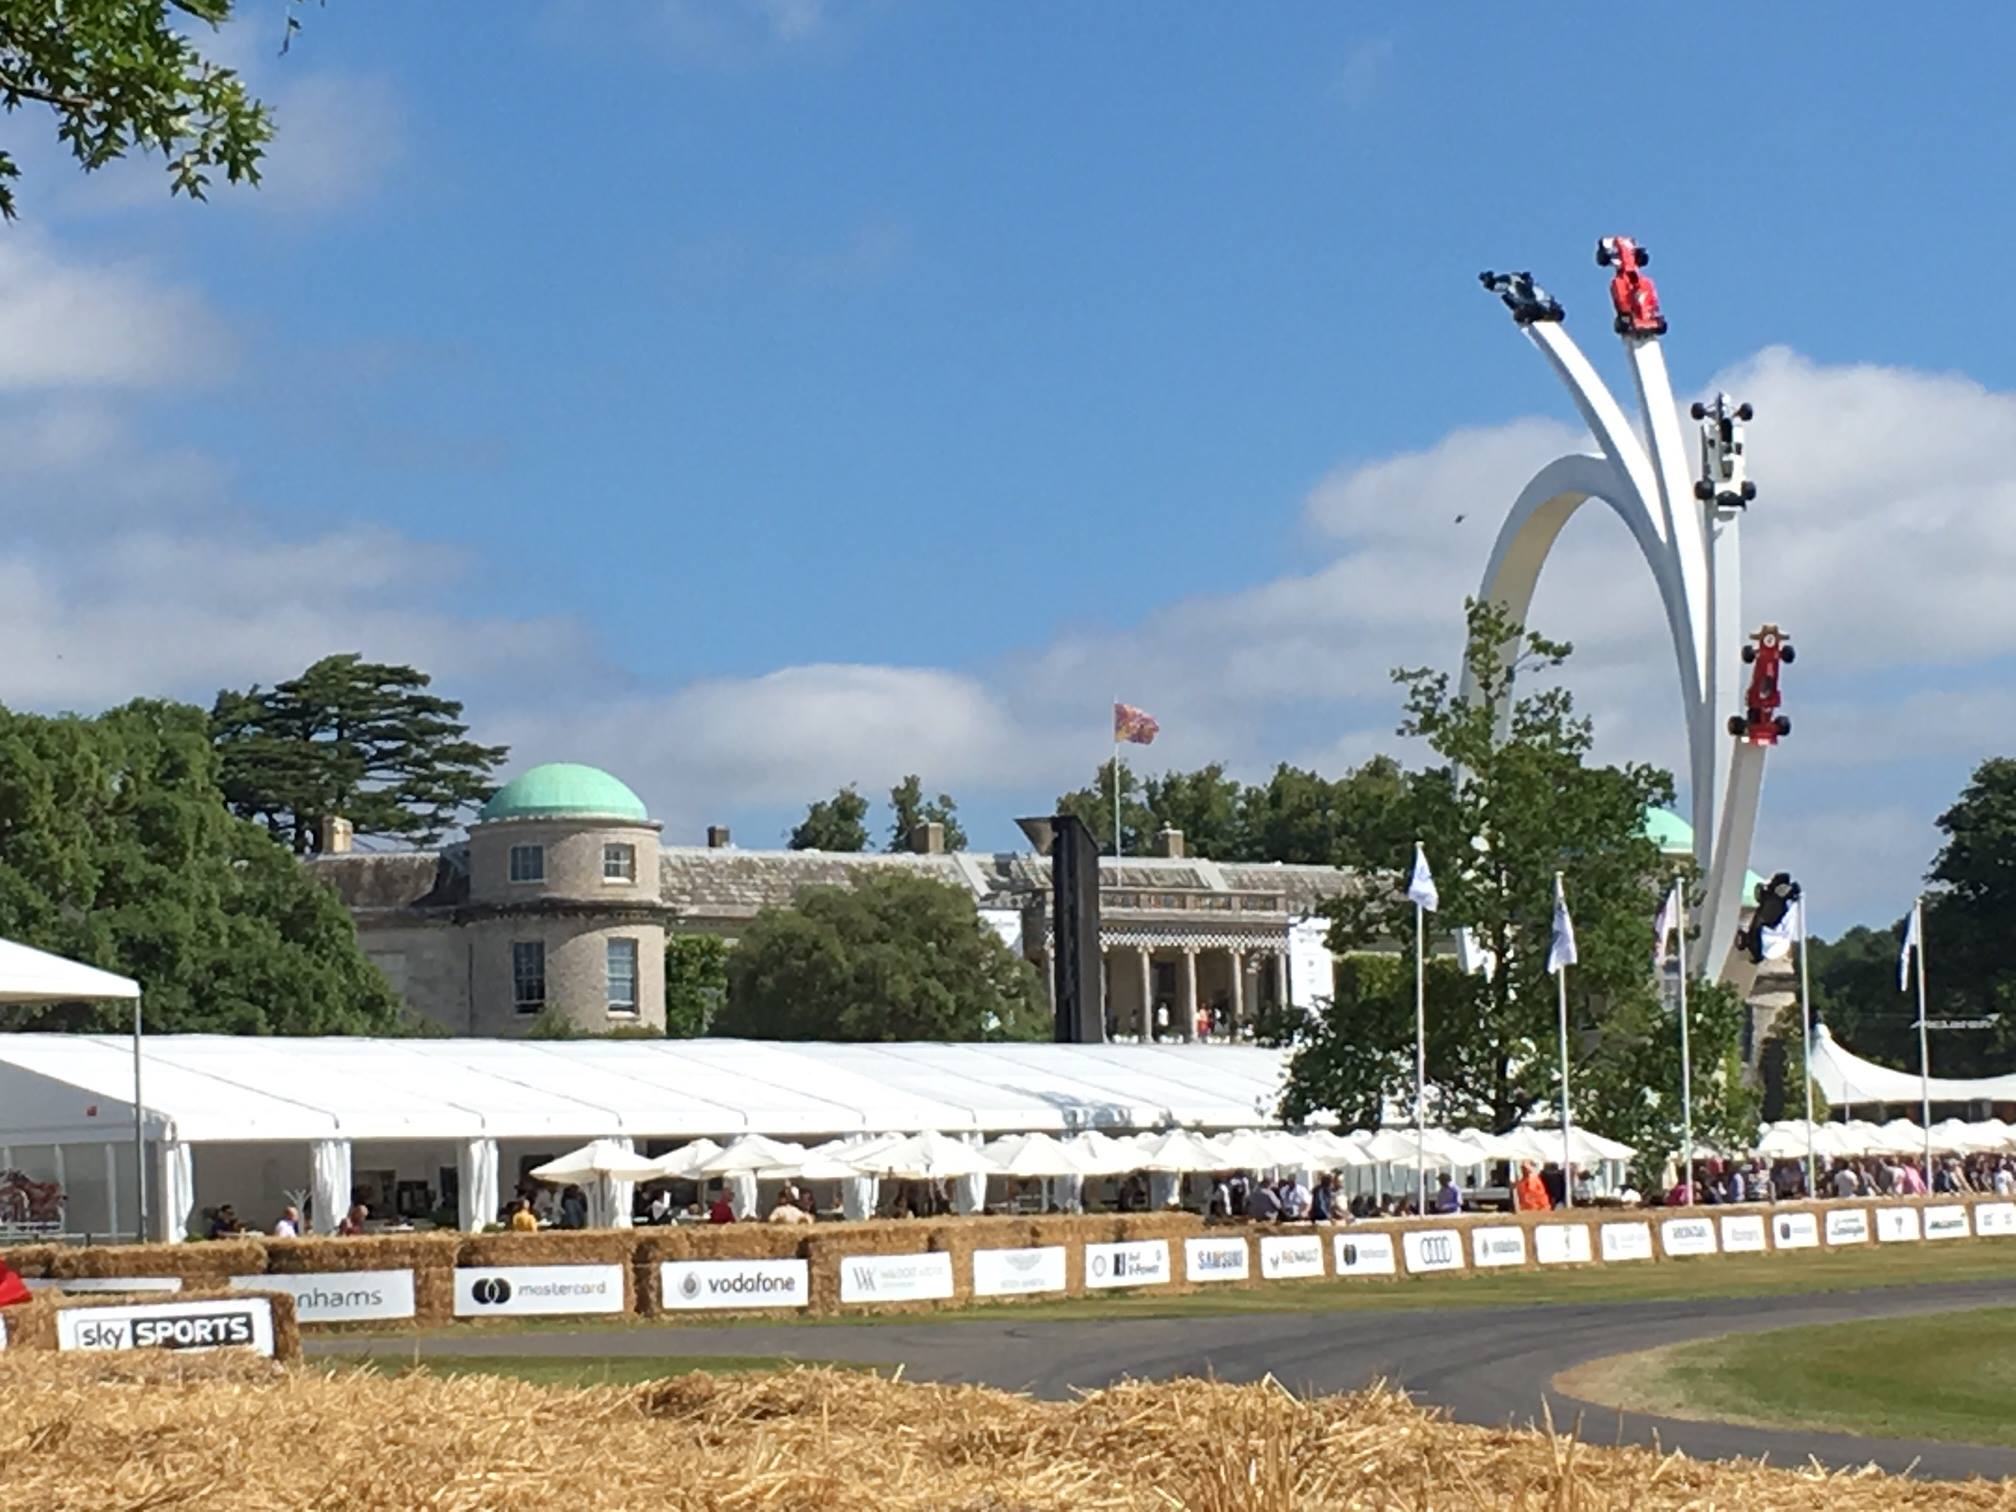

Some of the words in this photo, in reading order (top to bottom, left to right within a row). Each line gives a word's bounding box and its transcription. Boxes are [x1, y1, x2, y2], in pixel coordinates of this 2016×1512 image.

[518, 1281, 606, 1297] mastercard
[709, 1272, 795, 1294] vodafone
[296, 1287, 384, 1309] nhams
[82, 1322, 125, 1350] sky
[135, 1316, 248, 1346] SPORTS
